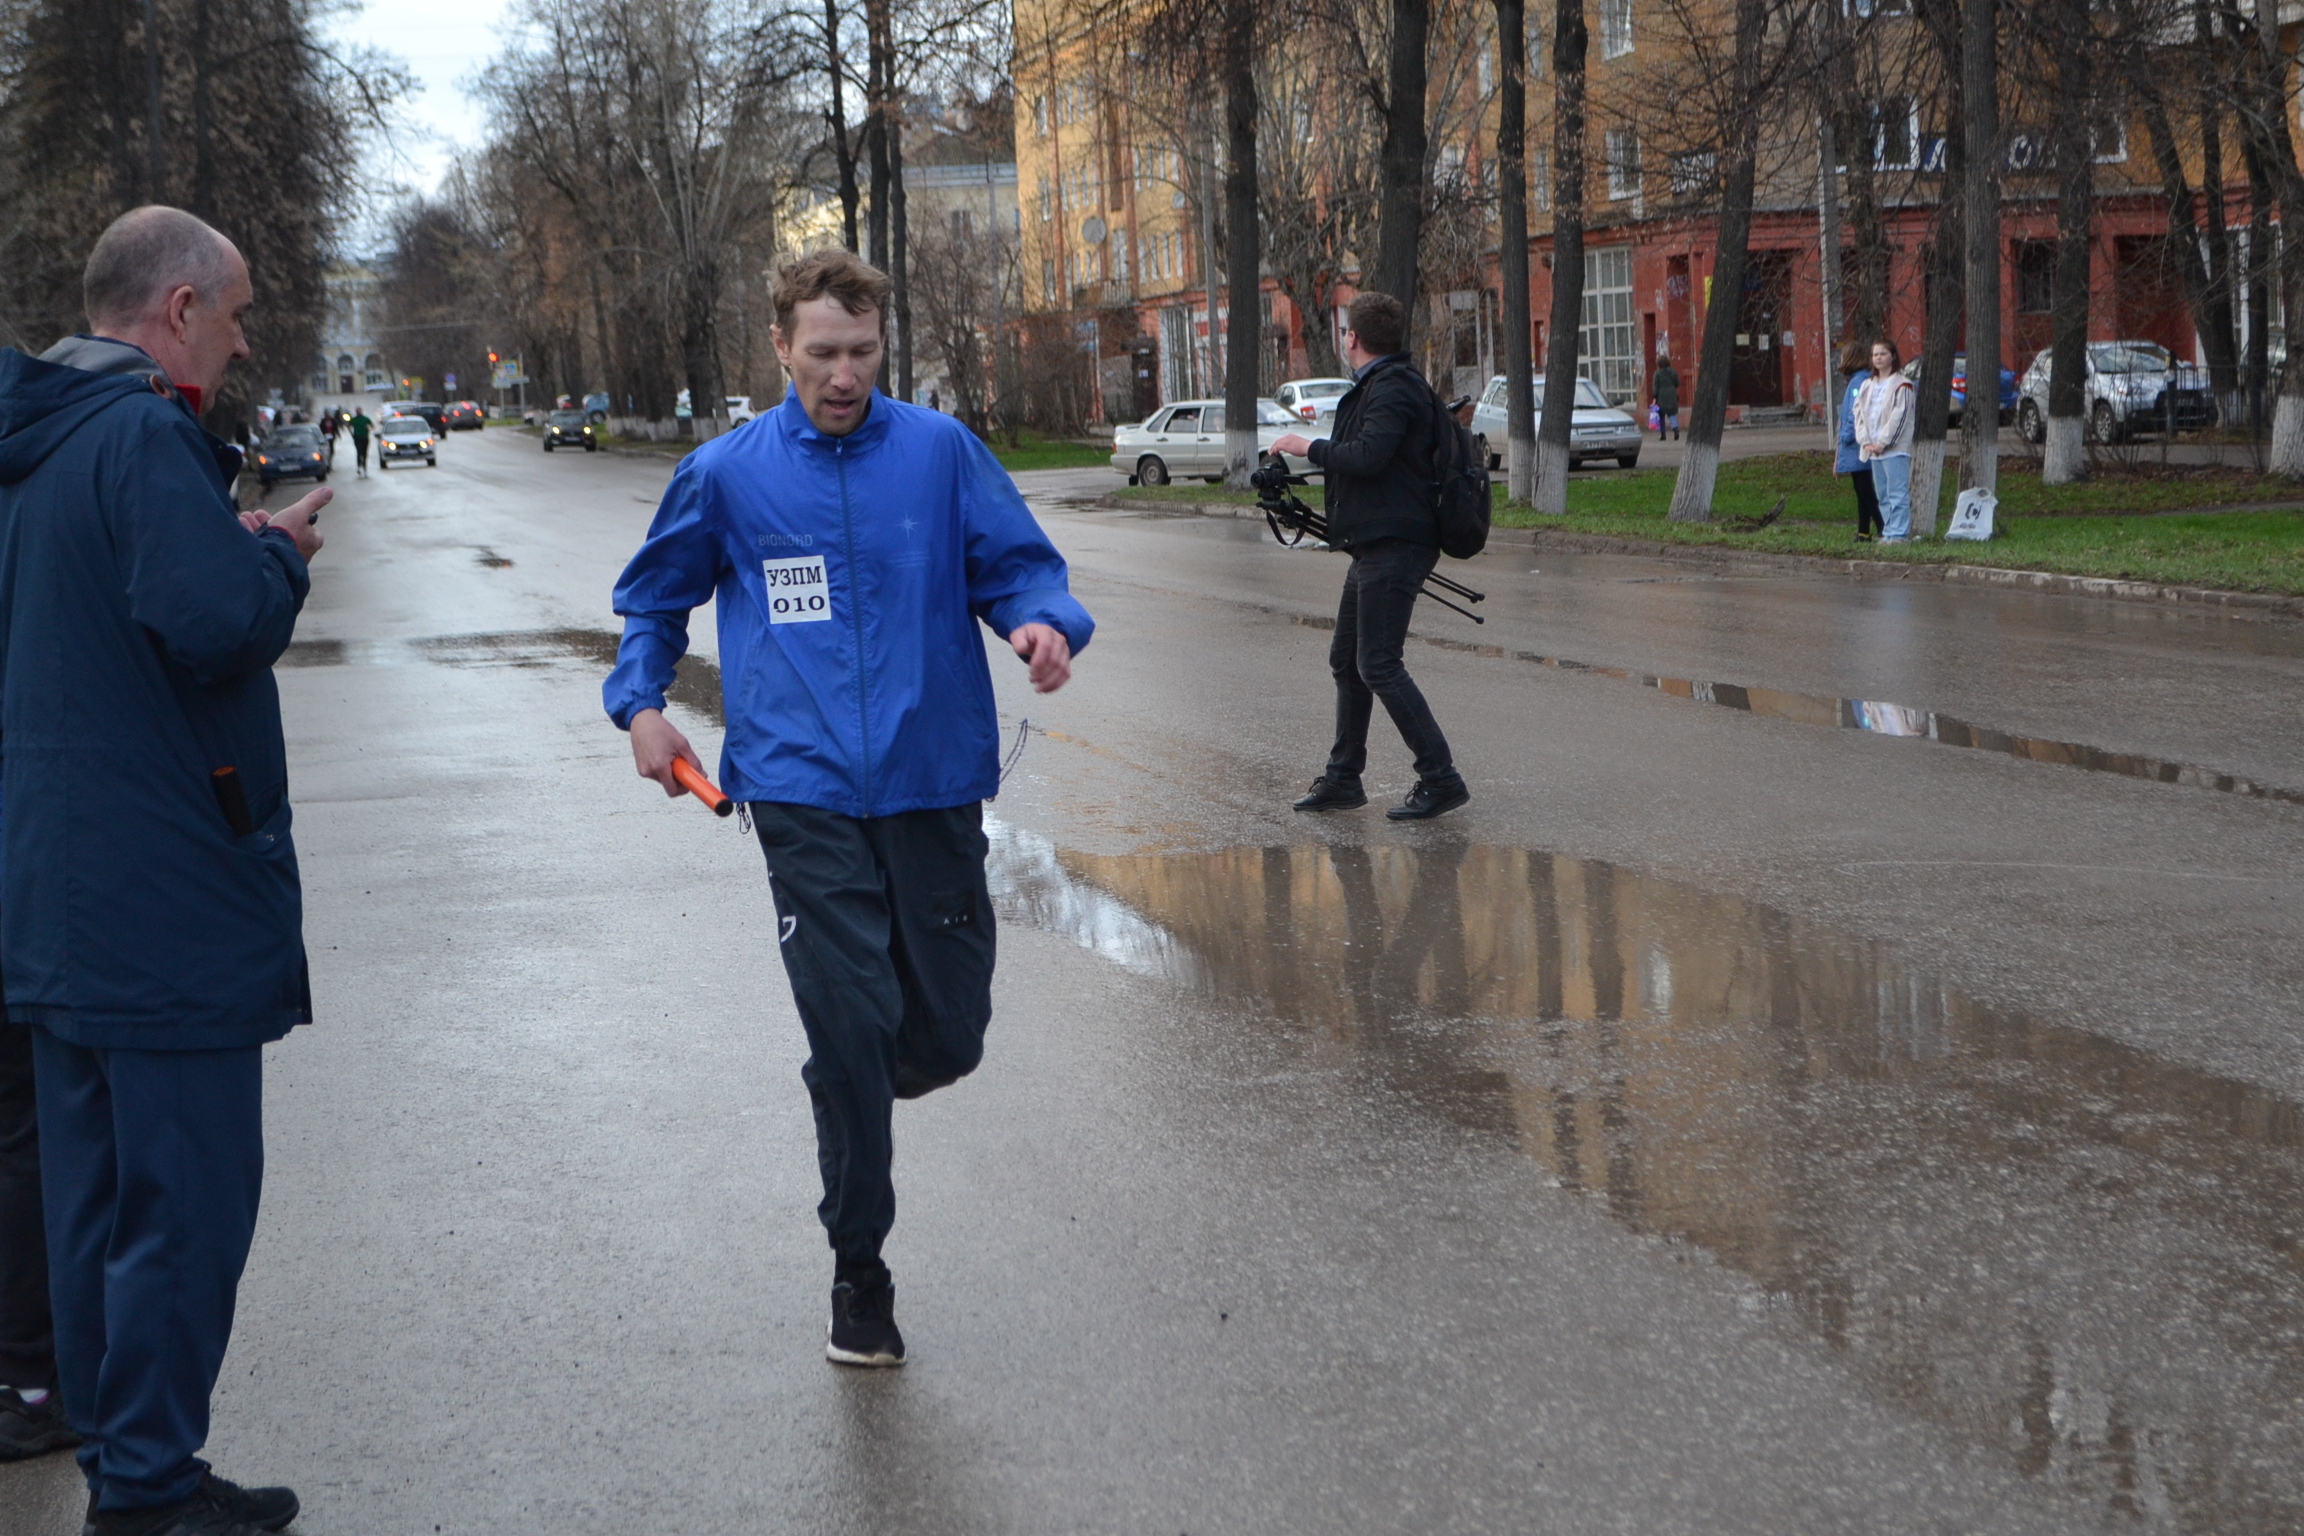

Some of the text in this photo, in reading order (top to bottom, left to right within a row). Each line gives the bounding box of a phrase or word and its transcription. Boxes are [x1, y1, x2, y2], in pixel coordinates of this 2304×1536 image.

[758, 534, 813, 547] BIONORD
[766, 565, 823, 587] УЗПМ
[773, 595, 825, 613] 010
